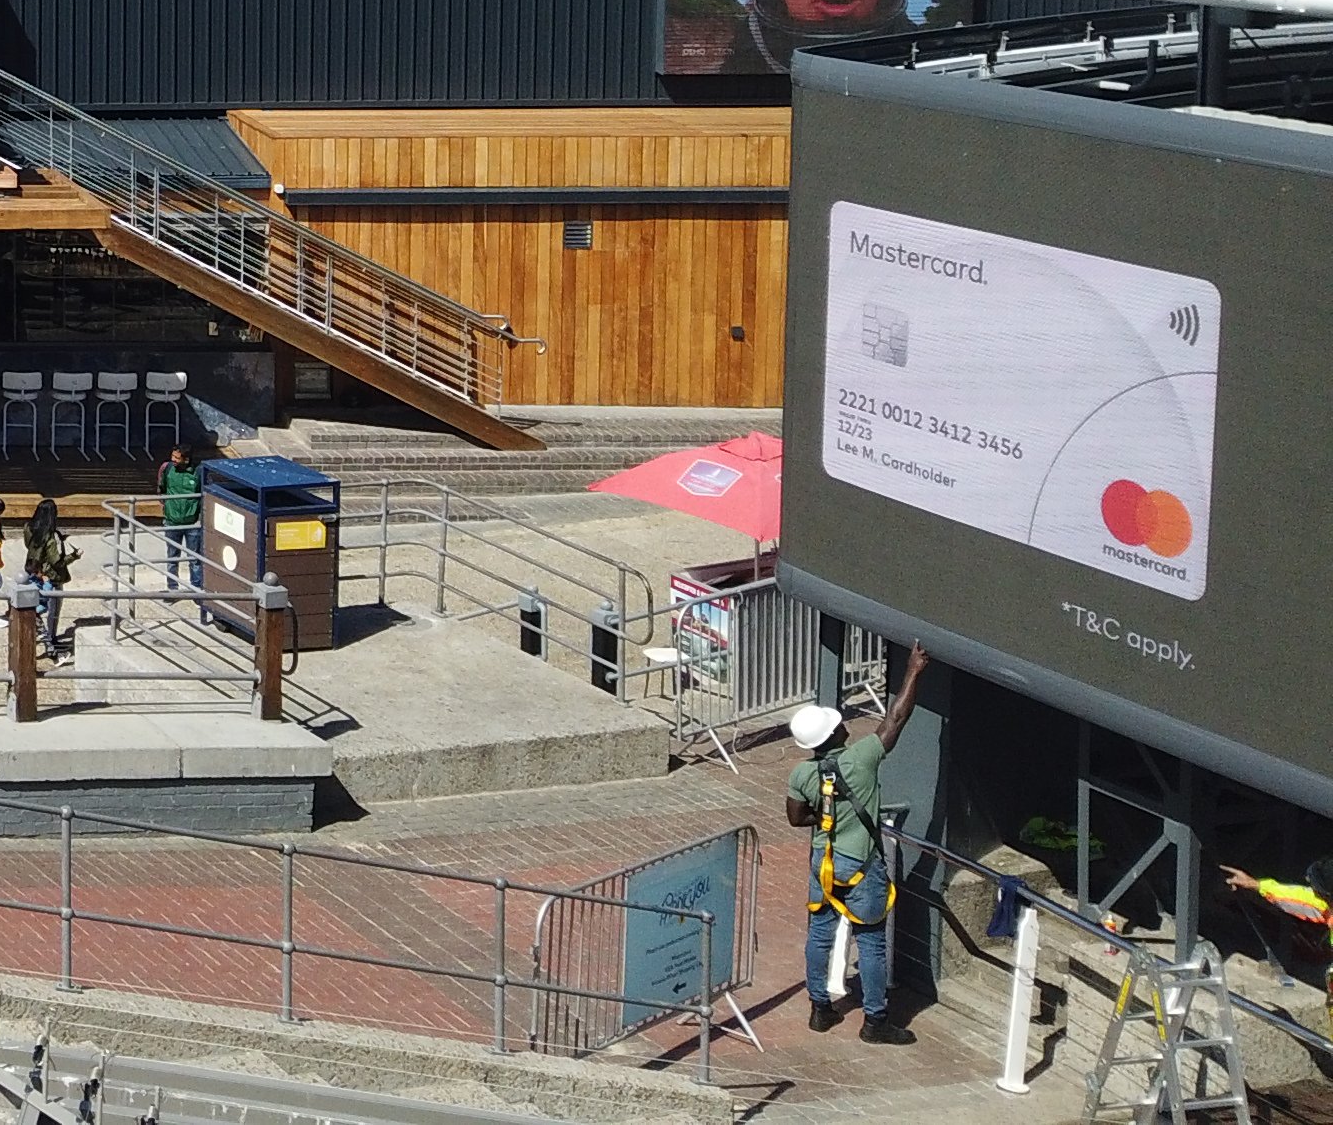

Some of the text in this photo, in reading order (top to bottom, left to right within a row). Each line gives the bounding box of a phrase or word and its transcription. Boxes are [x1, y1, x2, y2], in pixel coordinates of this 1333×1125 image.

[837, 388, 1023, 460] 2221 0012 3412 3456
[837, 419, 873, 441] 12/23
[836, 437, 859, 456] Lee
[881, 452, 958, 488] Cardholder
[1102, 543, 1187, 581] mastercard
[1126, 631, 1196, 671] apply.
